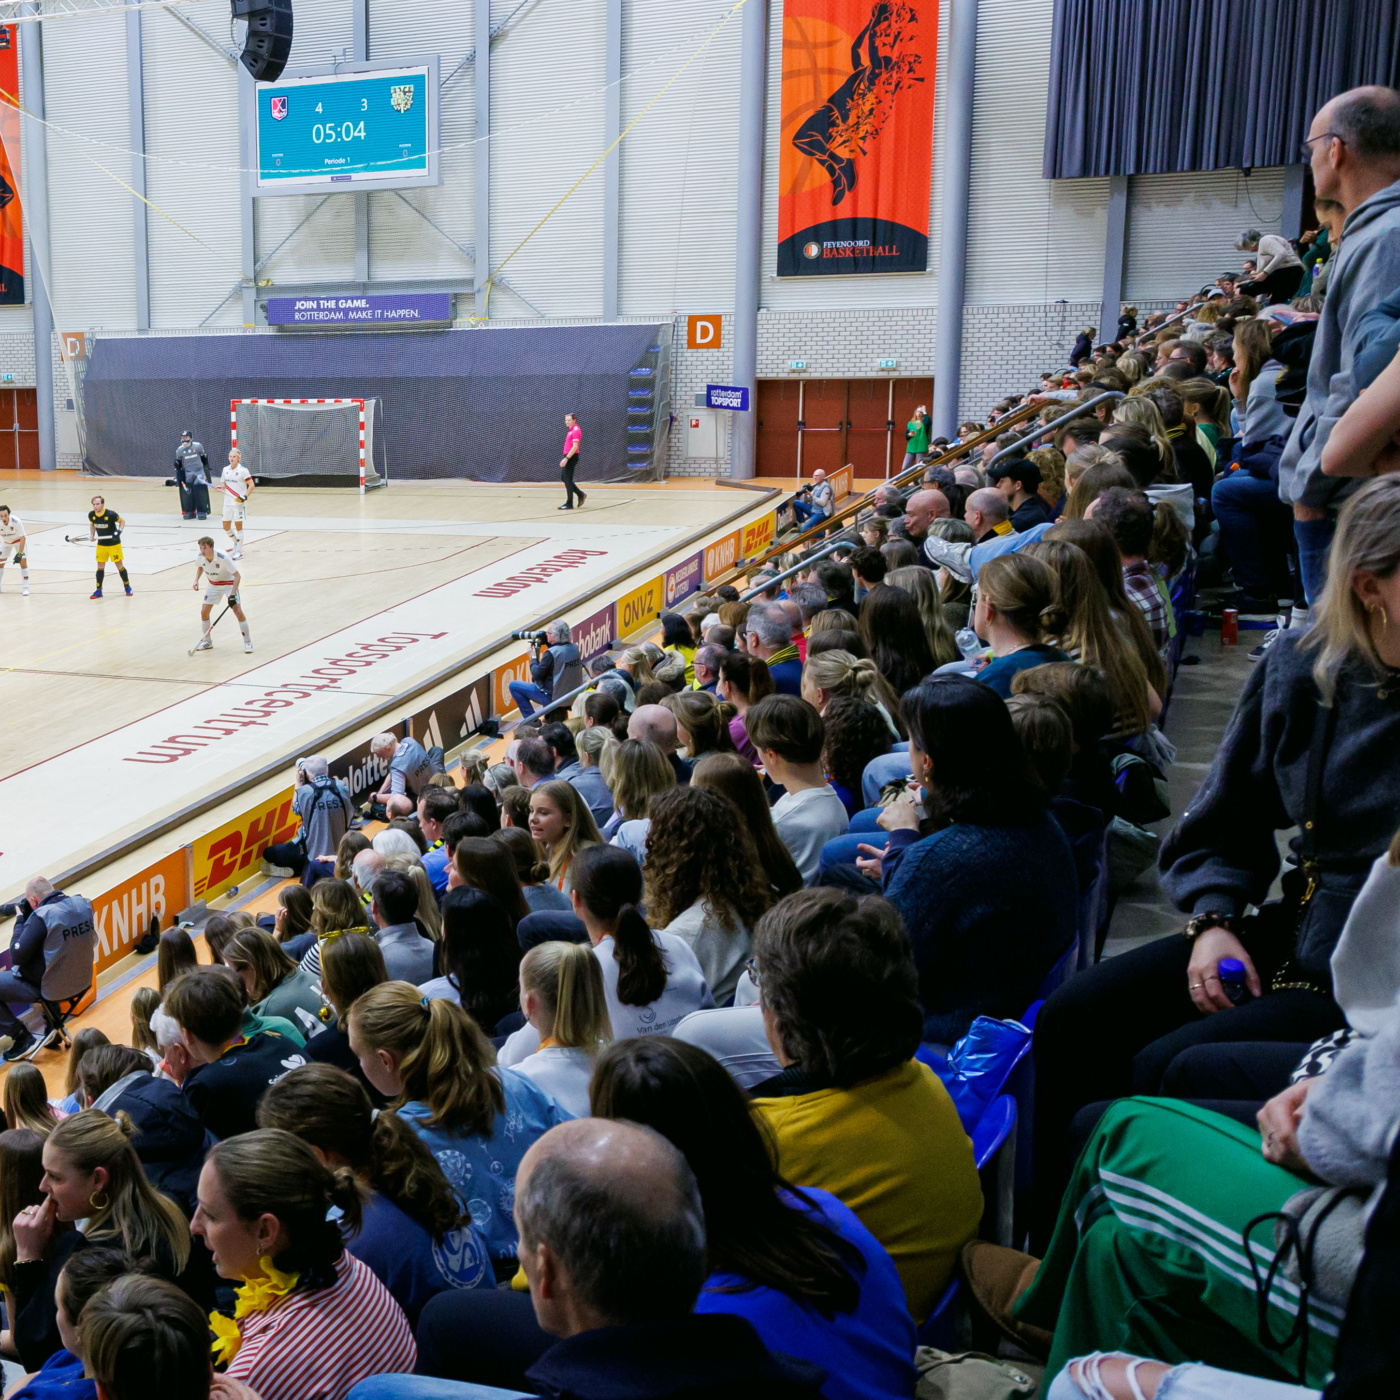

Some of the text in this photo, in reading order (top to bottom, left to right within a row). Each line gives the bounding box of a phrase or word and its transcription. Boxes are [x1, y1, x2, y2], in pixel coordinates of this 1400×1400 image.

[315, 102, 323, 114] 4
[360, 98, 368, 111] 3
[312, 121, 366, 144] 05:04
[822, 246, 900, 259] BASKETBALL
[823, 240, 870, 248] FEYENOORD
[294, 299, 370, 310] JOIN THE GAME.
[294, 309, 421, 321] ROTTERDAM. MAKE IT HAPPEN.
[695, 321, 715, 344] D
[66, 337, 80, 357] D
[711, 397, 742, 407] TOPSPORT
[744, 519, 770, 554] DHL
[715, 538, 735, 573] KNHB
[472, 548, 609, 599] Rotterdam
[623, 589, 654, 628] ONVZ
[576, 613, 611, 660] bobank
[564, 659, 580, 670] PRES
[206, 798, 298, 891] DHL
[93, 873, 166, 963] KNHB
[636, 1025, 652, 1034] Van
[654, 1021, 667, 1031] den
